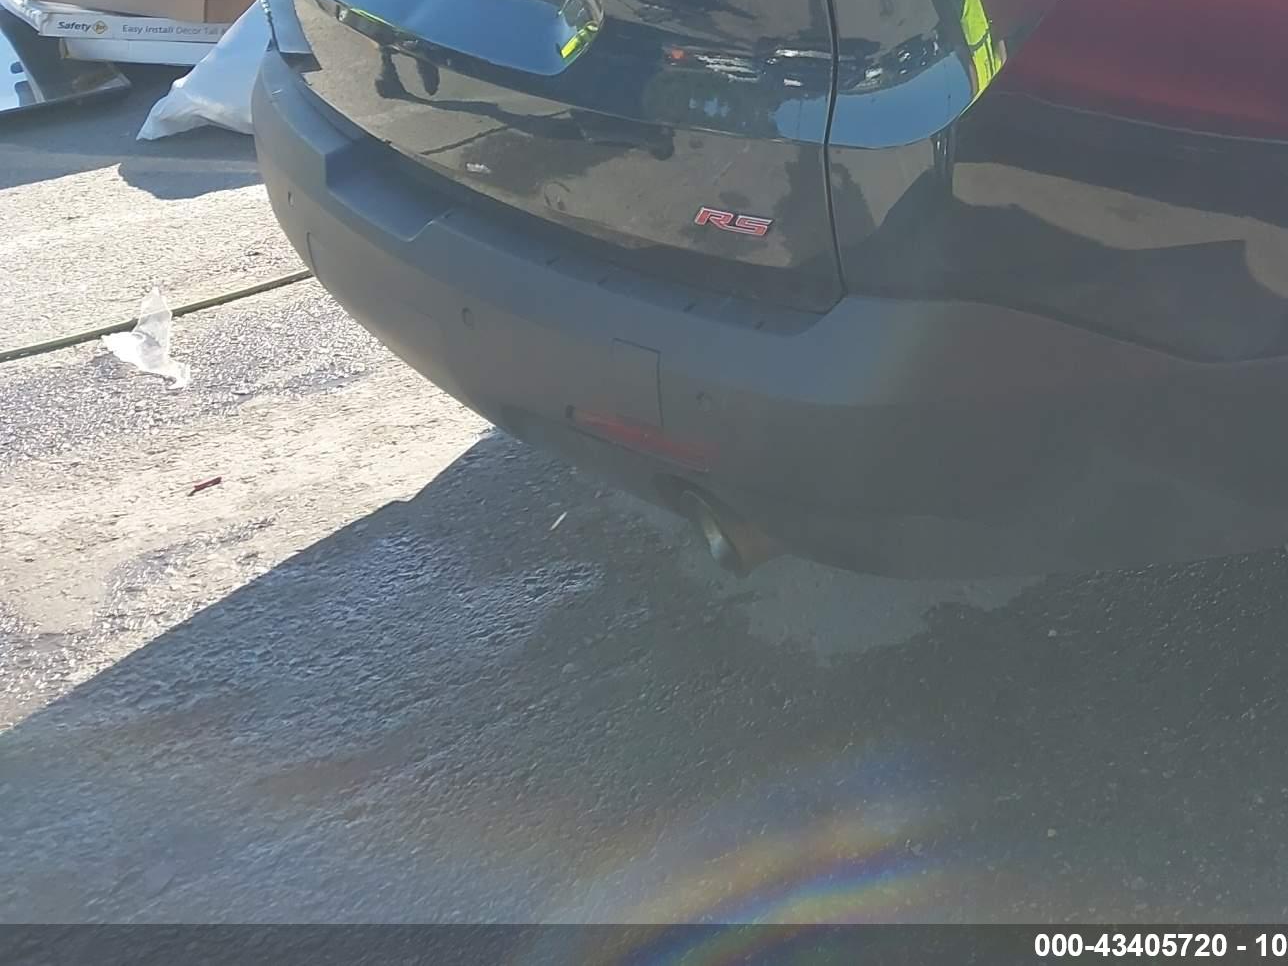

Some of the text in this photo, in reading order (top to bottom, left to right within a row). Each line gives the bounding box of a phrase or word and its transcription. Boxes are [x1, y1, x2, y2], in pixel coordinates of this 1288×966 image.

[57, 20, 92, 32] Safety
[122, 25, 142, 34] Easy
[145, 24, 173, 34] Install
[694, 206, 773, 237] RS
